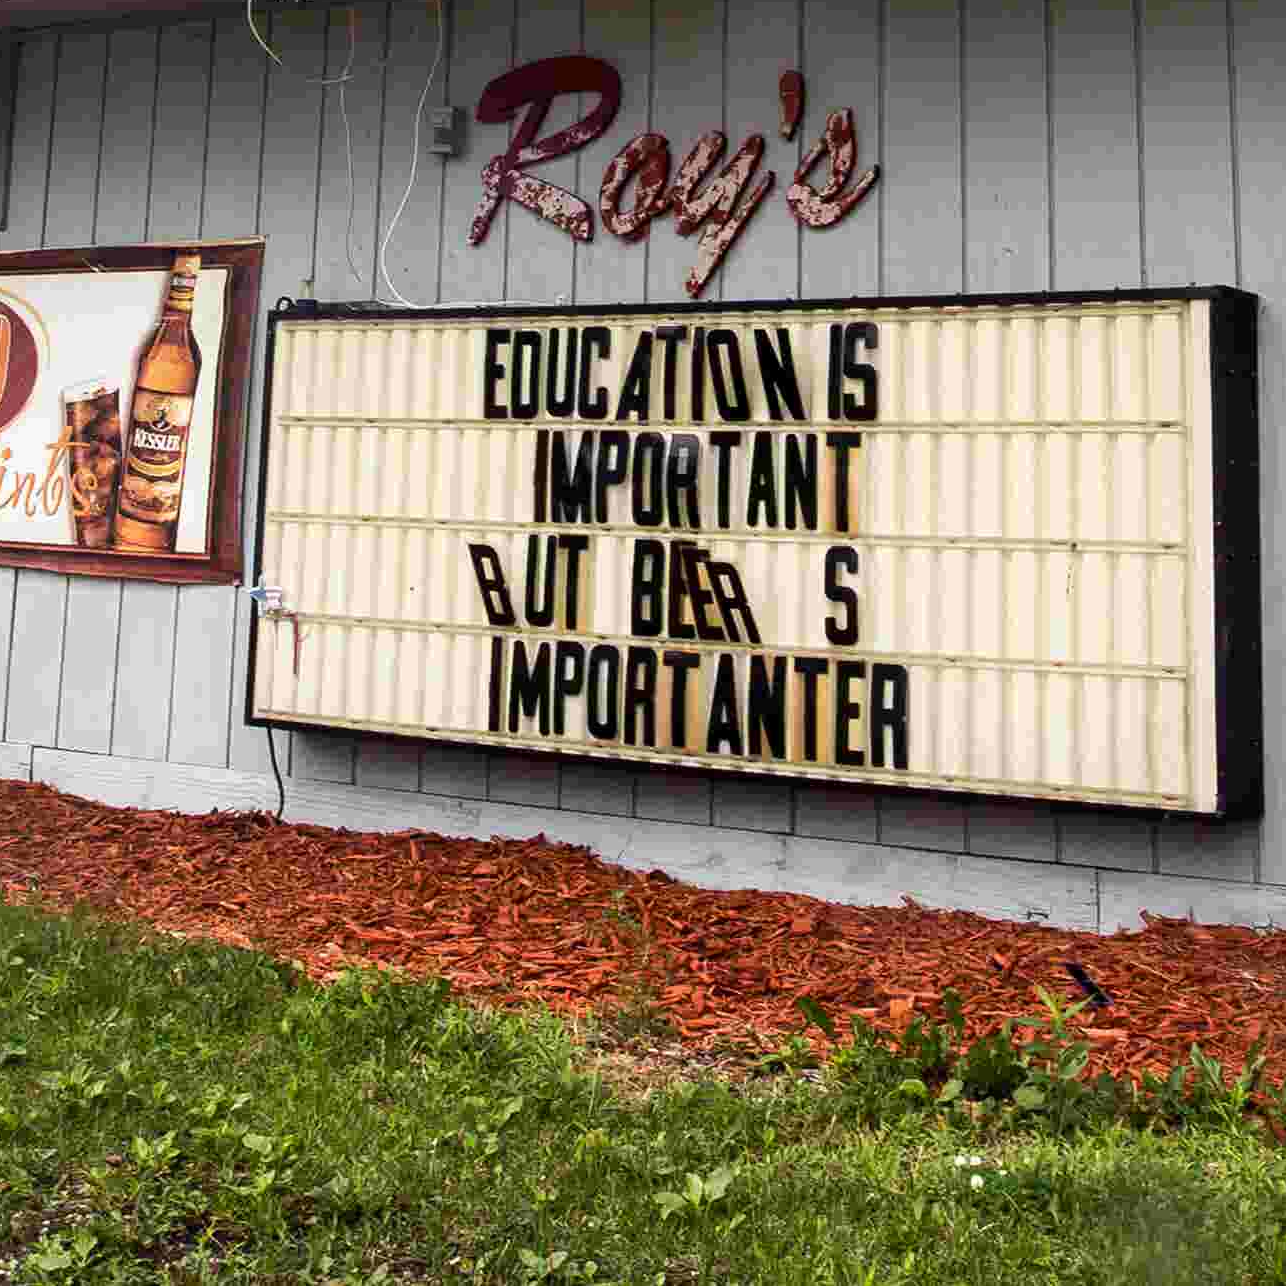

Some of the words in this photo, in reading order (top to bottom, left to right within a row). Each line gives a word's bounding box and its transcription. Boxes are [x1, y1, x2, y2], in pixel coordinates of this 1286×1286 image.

[469, 55, 881, 298] Roy's
[483, 325, 809, 422] EDUCATION
[827, 322, 879, 421] IS
[132, 427, 181, 452] KESSLER
[533, 428, 862, 534] IMPORTANT
[468, 534, 589, 631] BUT
[630, 538, 762, 644] BEER
[487, 635, 910, 771] IMPORTANTER
